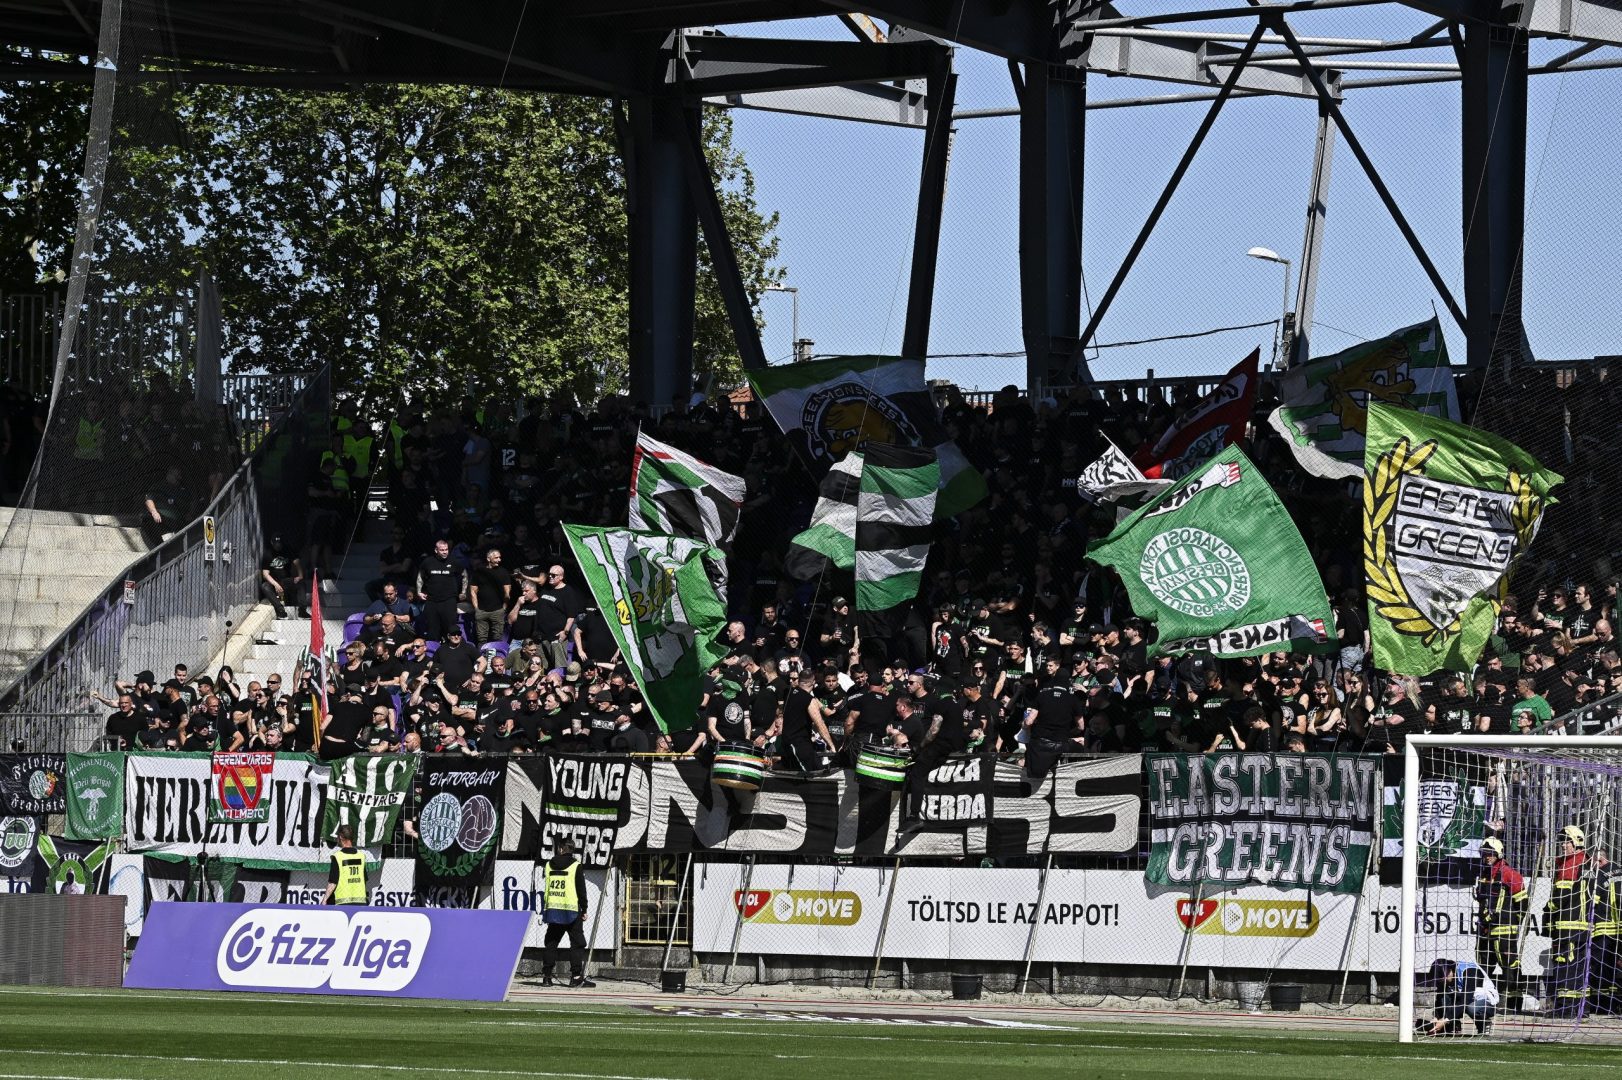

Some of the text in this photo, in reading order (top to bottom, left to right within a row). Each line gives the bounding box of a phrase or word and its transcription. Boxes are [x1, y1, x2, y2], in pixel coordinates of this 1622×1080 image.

[501, 448, 516, 466] 12
[1398, 523, 1509, 564] GREENS
[549, 755, 626, 802] YOUNG
[1150, 753, 1377, 820] EASTERN
[919, 793, 987, 821] ERDA
[1166, 820, 1352, 886] GREENS
[550, 880, 566, 890] 428
[796, 897, 855, 918] MOVE
[907, 895, 1120, 927] TÖLTSD LE AZ APPOT!
[1245, 908, 1311, 930] MOVE
[268, 922, 411, 979] fizz liga
